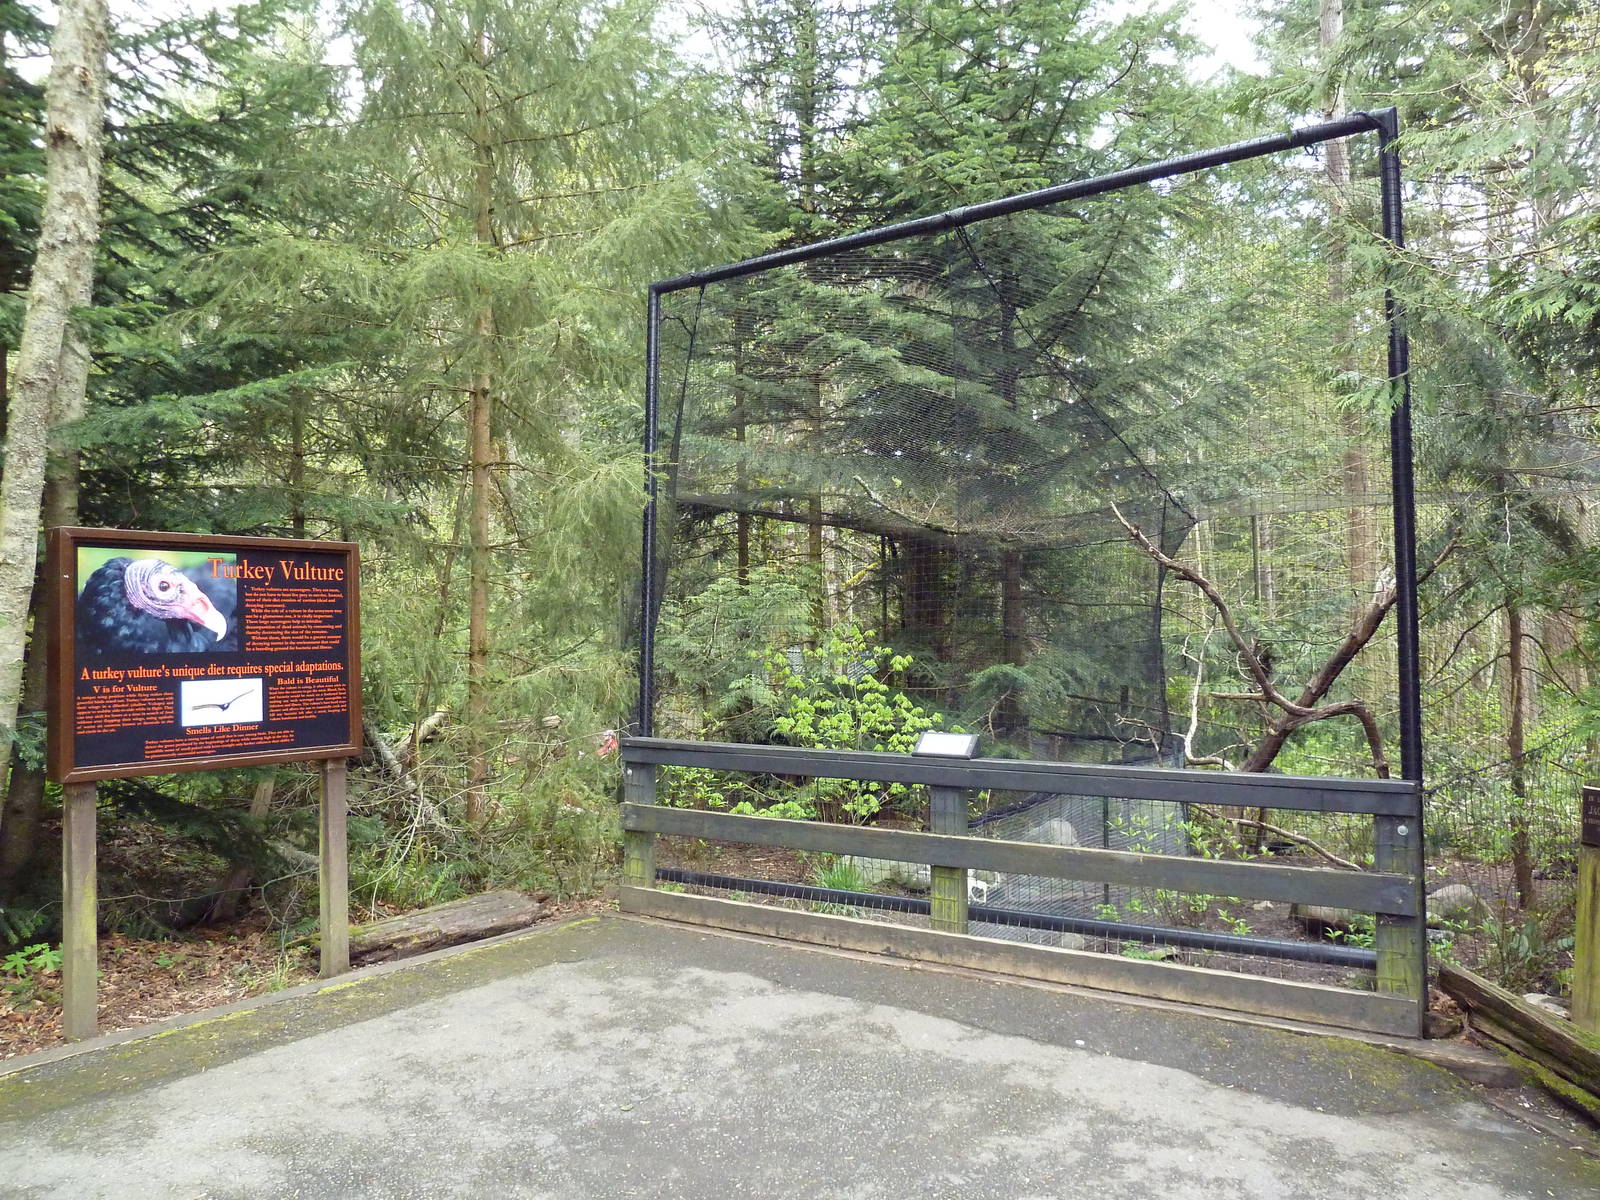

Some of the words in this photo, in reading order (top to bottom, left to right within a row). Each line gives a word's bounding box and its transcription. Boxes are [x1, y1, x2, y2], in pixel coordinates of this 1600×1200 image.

[208, 557, 275, 586] Turkey
[280, 560, 344, 581] Vulture
[81, 667, 90, 680] A
[92, 667, 125, 682] turkey
[127, 664, 170, 678] vulture's
[172, 664, 205, 680] unique
[208, 663, 225, 676] diet
[227, 662, 262, 678] requires
[264, 661, 293, 677] special
[295, 660, 344, 675] adaptations.
[277, 677, 295, 686] Bald
[297, 677, 303, 685] is
[305, 676, 339, 684] Beautiful
[93, 685, 102, 693] V
[102, 685, 110, 693] is
[112, 684, 124, 693] for
[126, 683, 158, 692] Vulture
[186, 725, 212, 735] Smells
[214, 724, 231, 733] Like
[232, 723, 259, 731] Dinner
